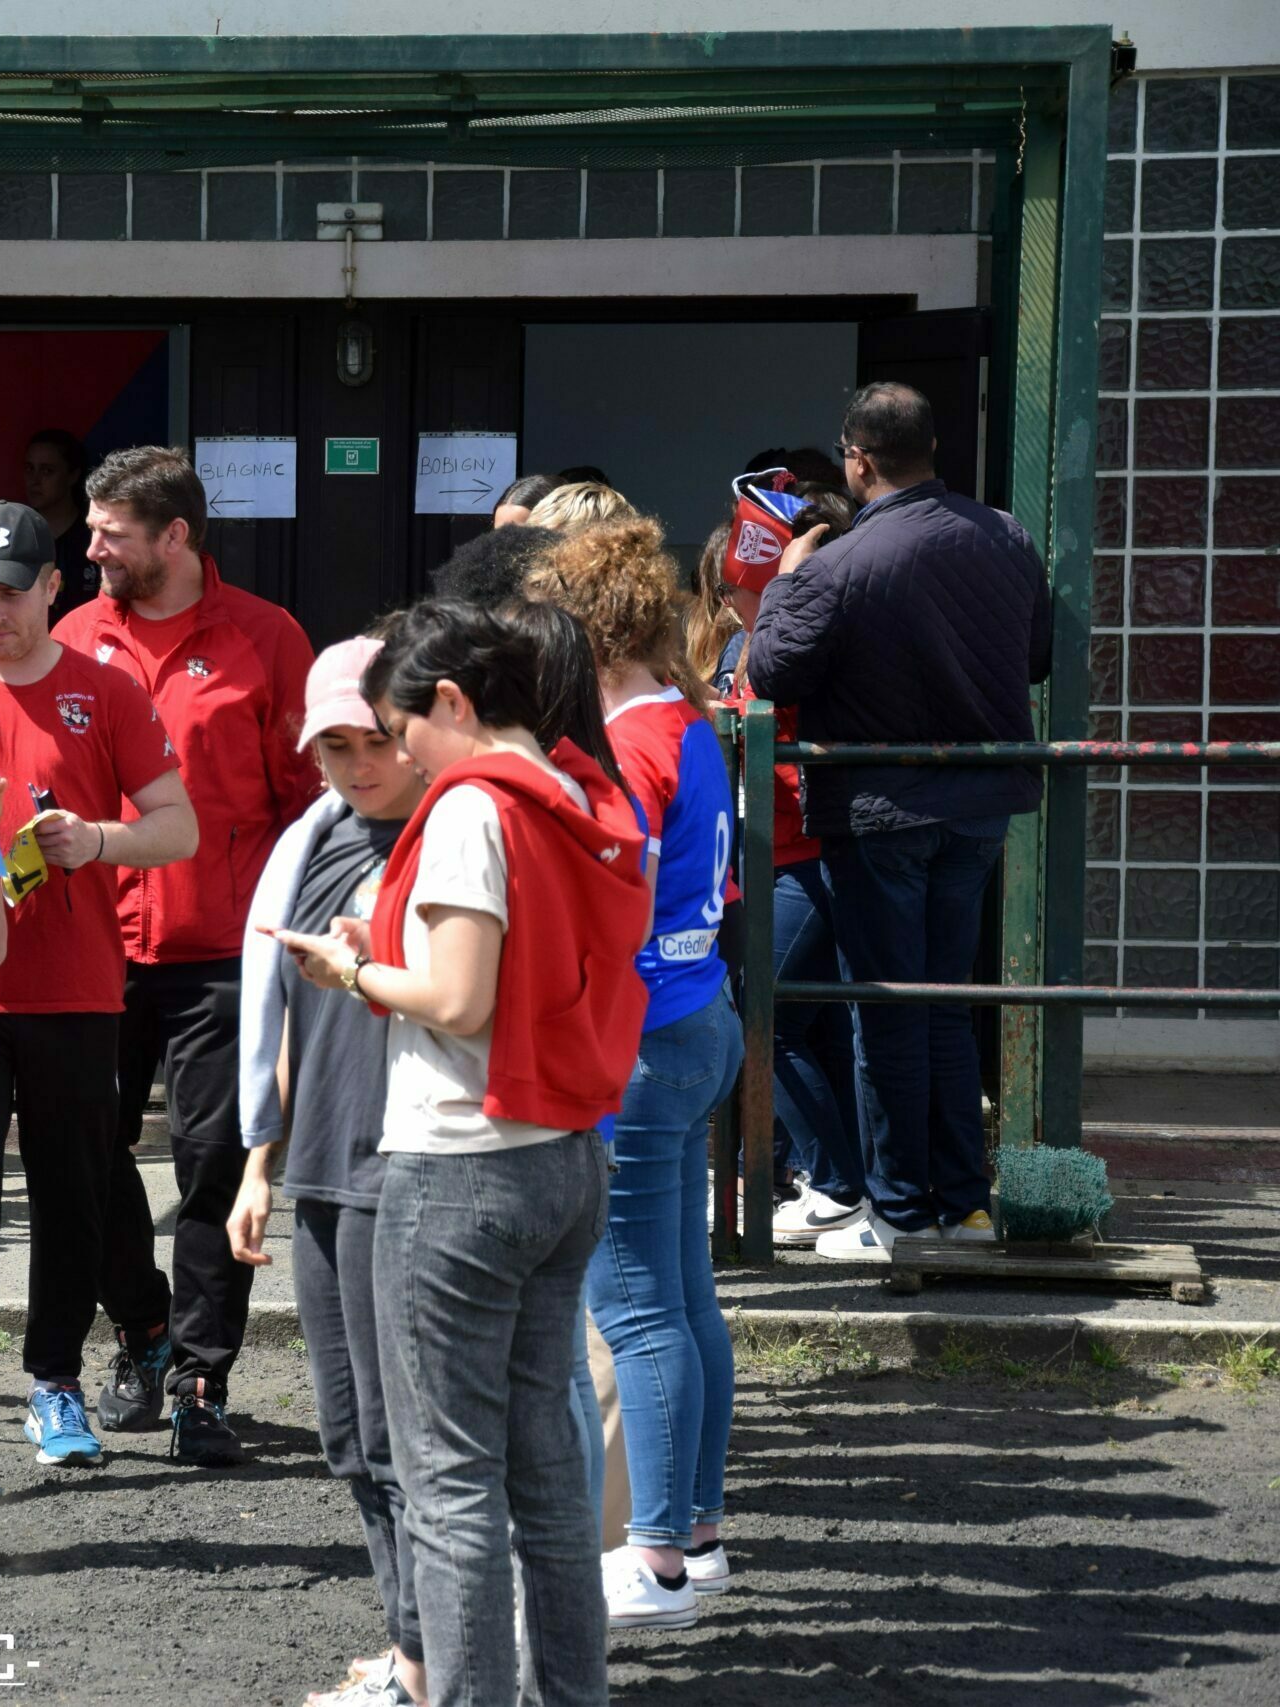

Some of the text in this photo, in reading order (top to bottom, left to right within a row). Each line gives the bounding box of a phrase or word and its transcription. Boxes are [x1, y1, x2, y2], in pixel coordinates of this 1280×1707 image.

[200, 462, 285, 480] BLAGNAC
[419, 456, 496, 475] BOBIGNY
[661, 935, 707, 956] Crédit
